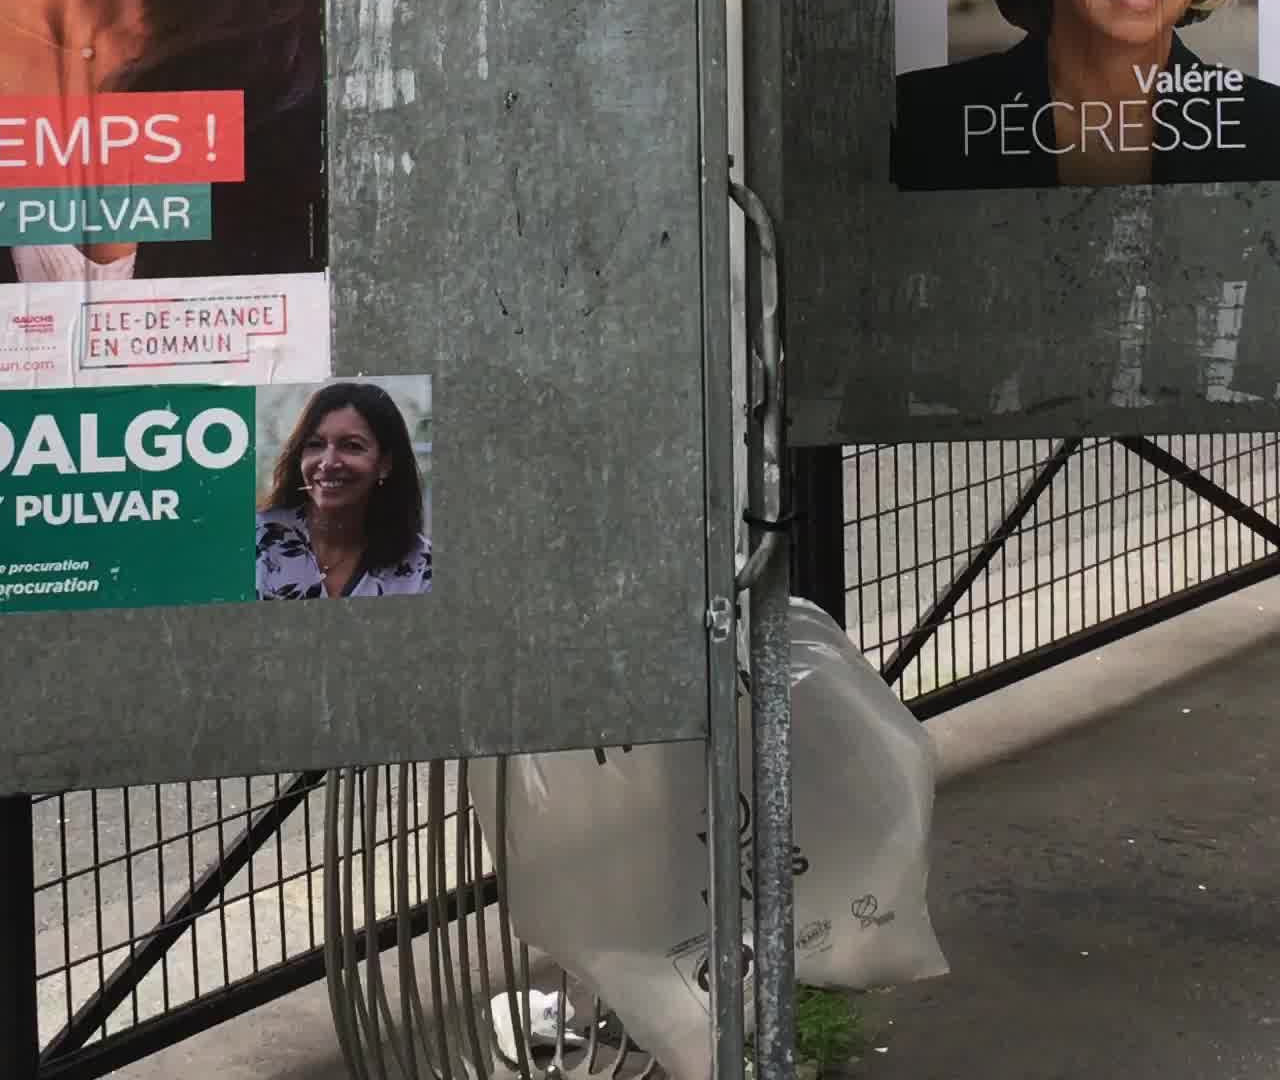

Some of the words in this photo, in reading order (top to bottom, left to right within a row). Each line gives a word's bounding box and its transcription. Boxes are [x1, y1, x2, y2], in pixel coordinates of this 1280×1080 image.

[1133, 63, 1244, 94] Valérie
[963, 92, 1247, 157] PÉCRESSE
[19, 197, 191, 233] PULVAR
[90, 338, 119, 357] EN
[130, 334, 231, 354] COMMUN
[14, 488, 180, 526] PULVAR
[8, 559, 89, 576] procuration
